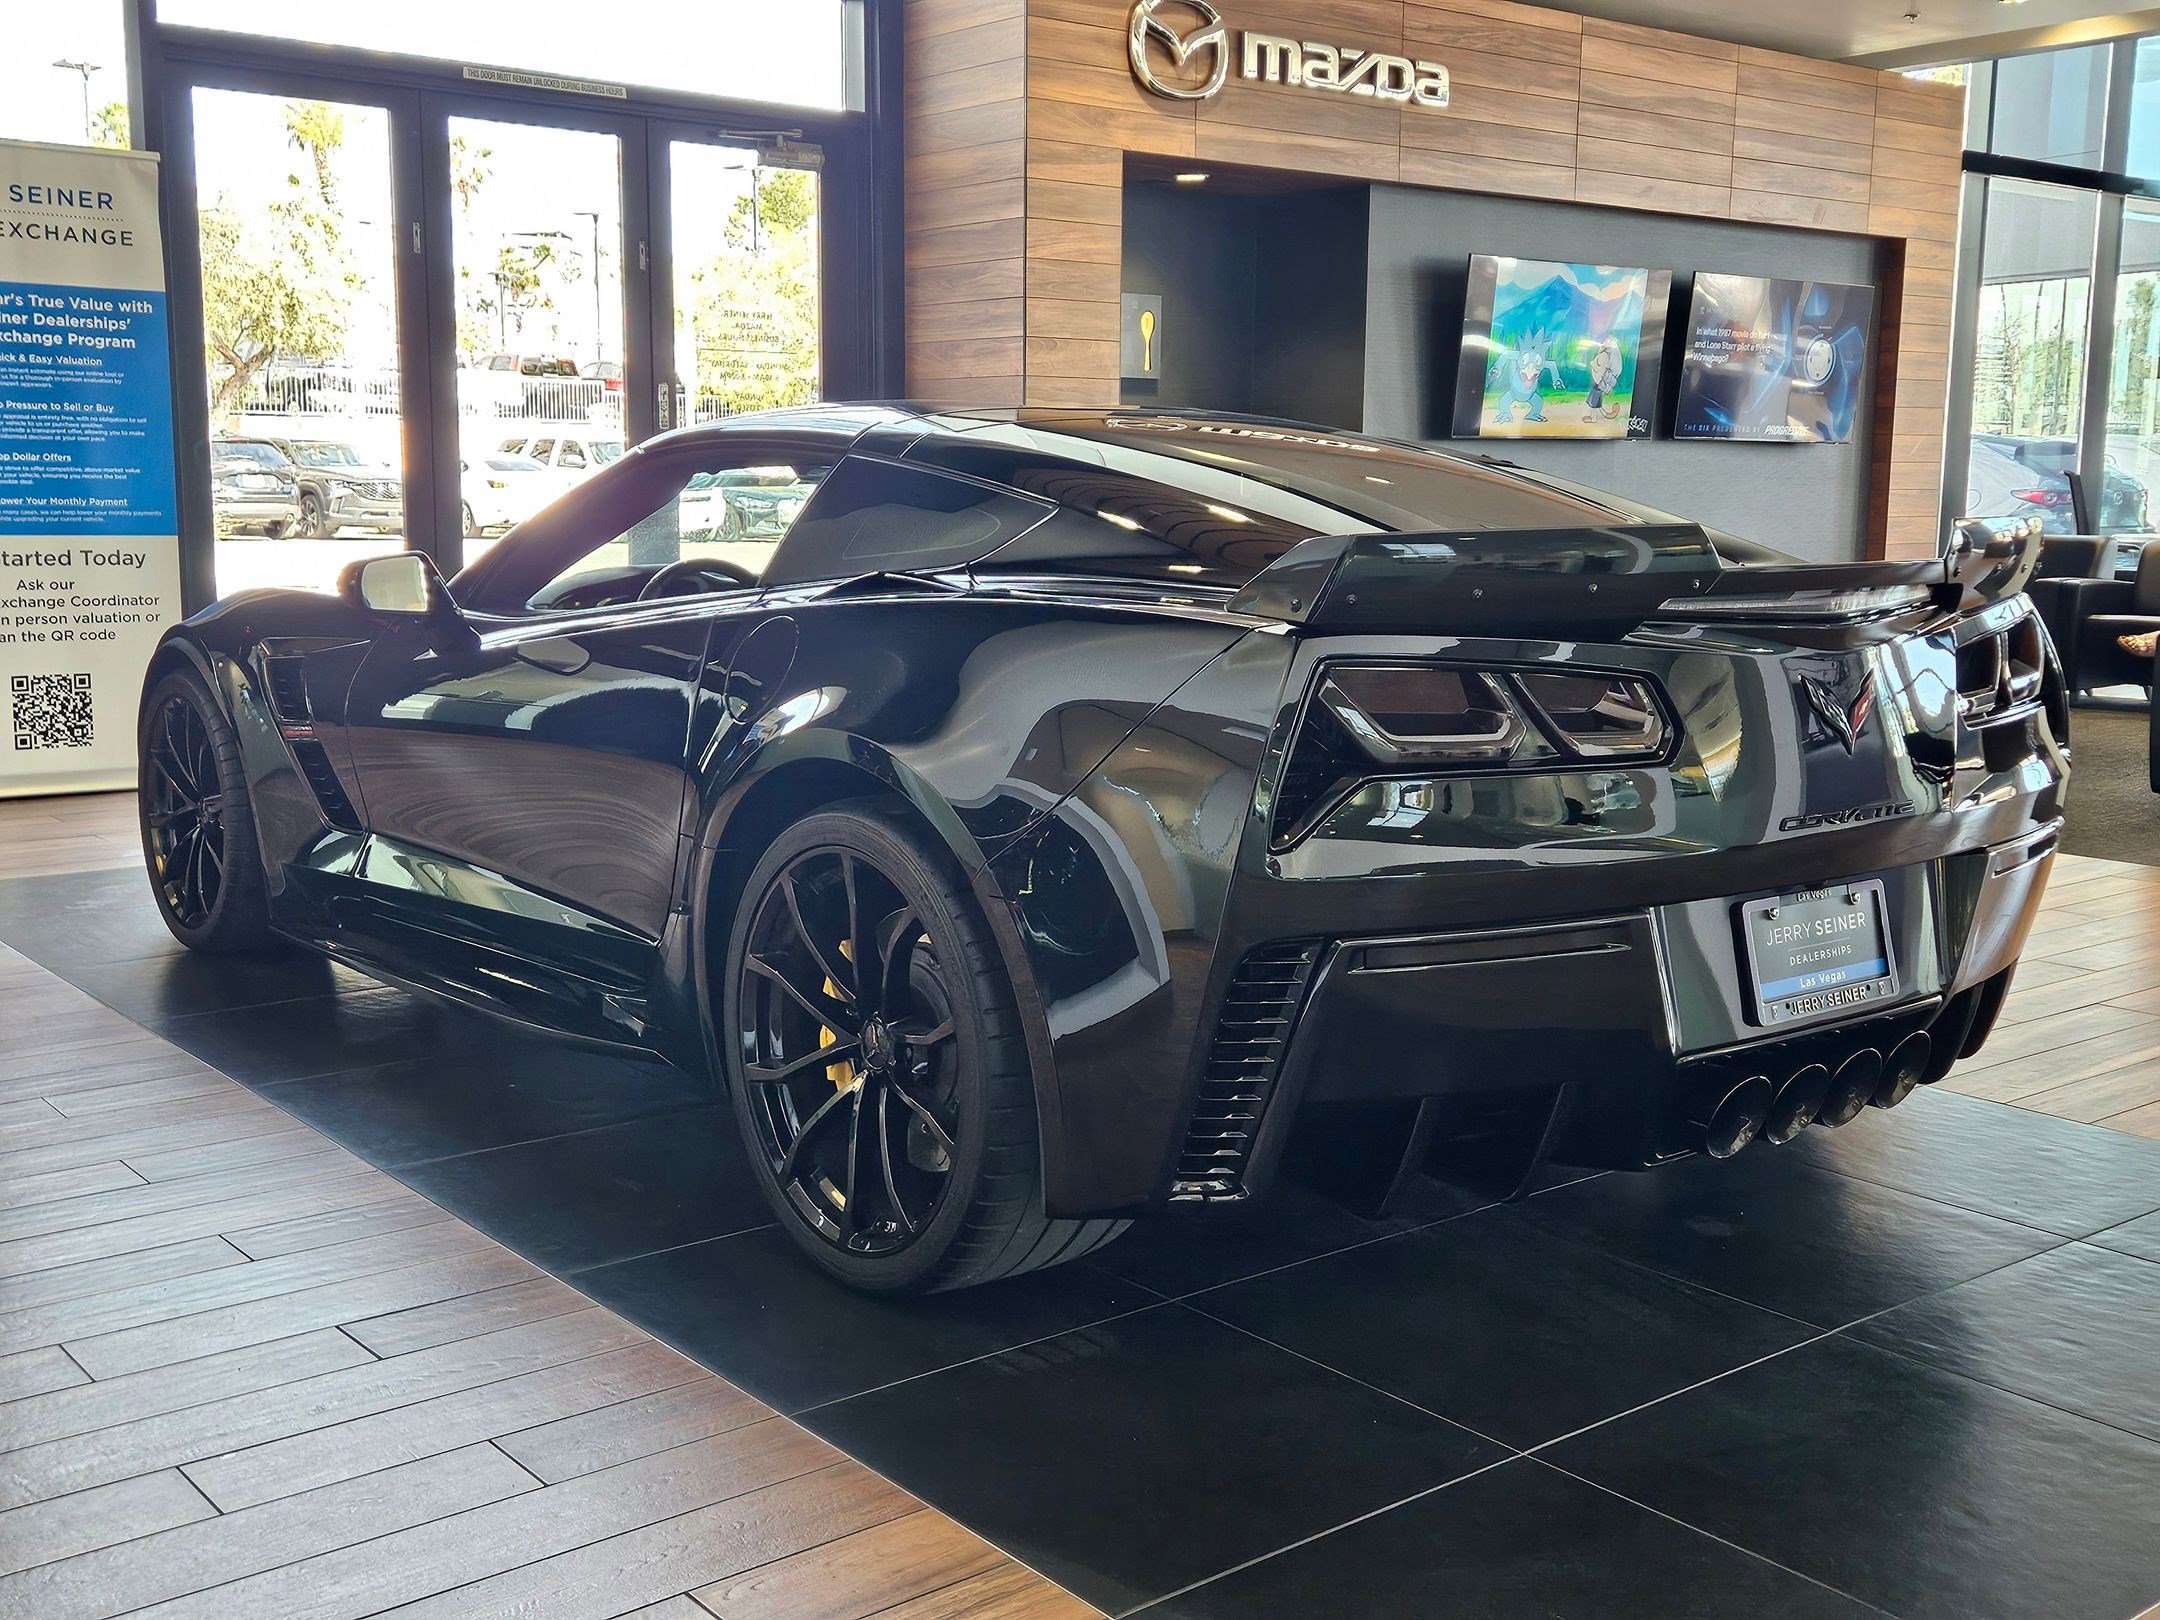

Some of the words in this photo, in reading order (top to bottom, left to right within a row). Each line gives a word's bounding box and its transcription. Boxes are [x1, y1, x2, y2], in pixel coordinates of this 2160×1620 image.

[1242, 31, 1450, 107] mazda
[467, 69, 480, 78] THIS
[481, 71, 496, 80] DOOR
[497, 73, 512, 82] MUST
[513, 75, 532, 85] REMAIN
[561, 80, 581, 91] DURING
[581, 83, 606, 94] BUSINESS
[606, 87, 623, 96] HOURS
[9, 184, 113, 210] SEINER
[28, 294, 65, 308] True
[69, 297, 113, 311] Value
[119, 301, 153, 314] with
[34, 313, 131, 332] Dealerships'
[68, 333, 136, 349] Program
[1704, 328, 1718, 337] what
[1732, 330, 1749, 339] movie
[1707, 341, 1721, 349] Lone
[19, 354, 26, 362] &
[29, 354, 52, 365] Easy
[55, 356, 103, 366] Valuation
[6, 401, 48, 410] Pressure
[51, 403, 61, 411] to
[64, 403, 81, 412] Sell
[97, 404, 114, 414] Buy
[1685, 424, 1696, 432] THE
[1699, 424, 1710, 432] SIX
[13, 453, 40, 462] Dollar
[43, 453, 72, 462] Offers
[26, 497, 47, 506] Your
[50, 498, 87, 507] Monthly
[90, 498, 128, 508] Payment
[2, 550, 72, 567] tarted
[80, 550, 146, 569] Today
[17, 579, 45, 591] Ask
[50, 581, 75, 591] our
[2, 597, 65, 610] xchange
[71, 595, 160, 607] Coordinator
[16, 615, 68, 628] person
[73, 612, 141, 624] valuation
[146, 613, 161, 623] or
[0, 633, 16, 643] an
[22, 631, 46, 642] the
[51, 630, 74, 642] QR
[80, 629, 116, 640] code
[1779, 800, 1916, 832] CORVETTE
[1797, 892, 1809, 902] Las
[1811, 888, 1832, 901] Vegas
[1767, 922, 1812, 946] JERRY
[1816, 912, 1866, 936] SEINER
[1790, 945, 1852, 966] DEALERSHIPS
[1800, 975, 1816, 989] Las
[1820, 969, 1847, 984] Vegas
[1791, 995, 1825, 1016] JERRY
[1827, 986, 1867, 1007] SEINER
